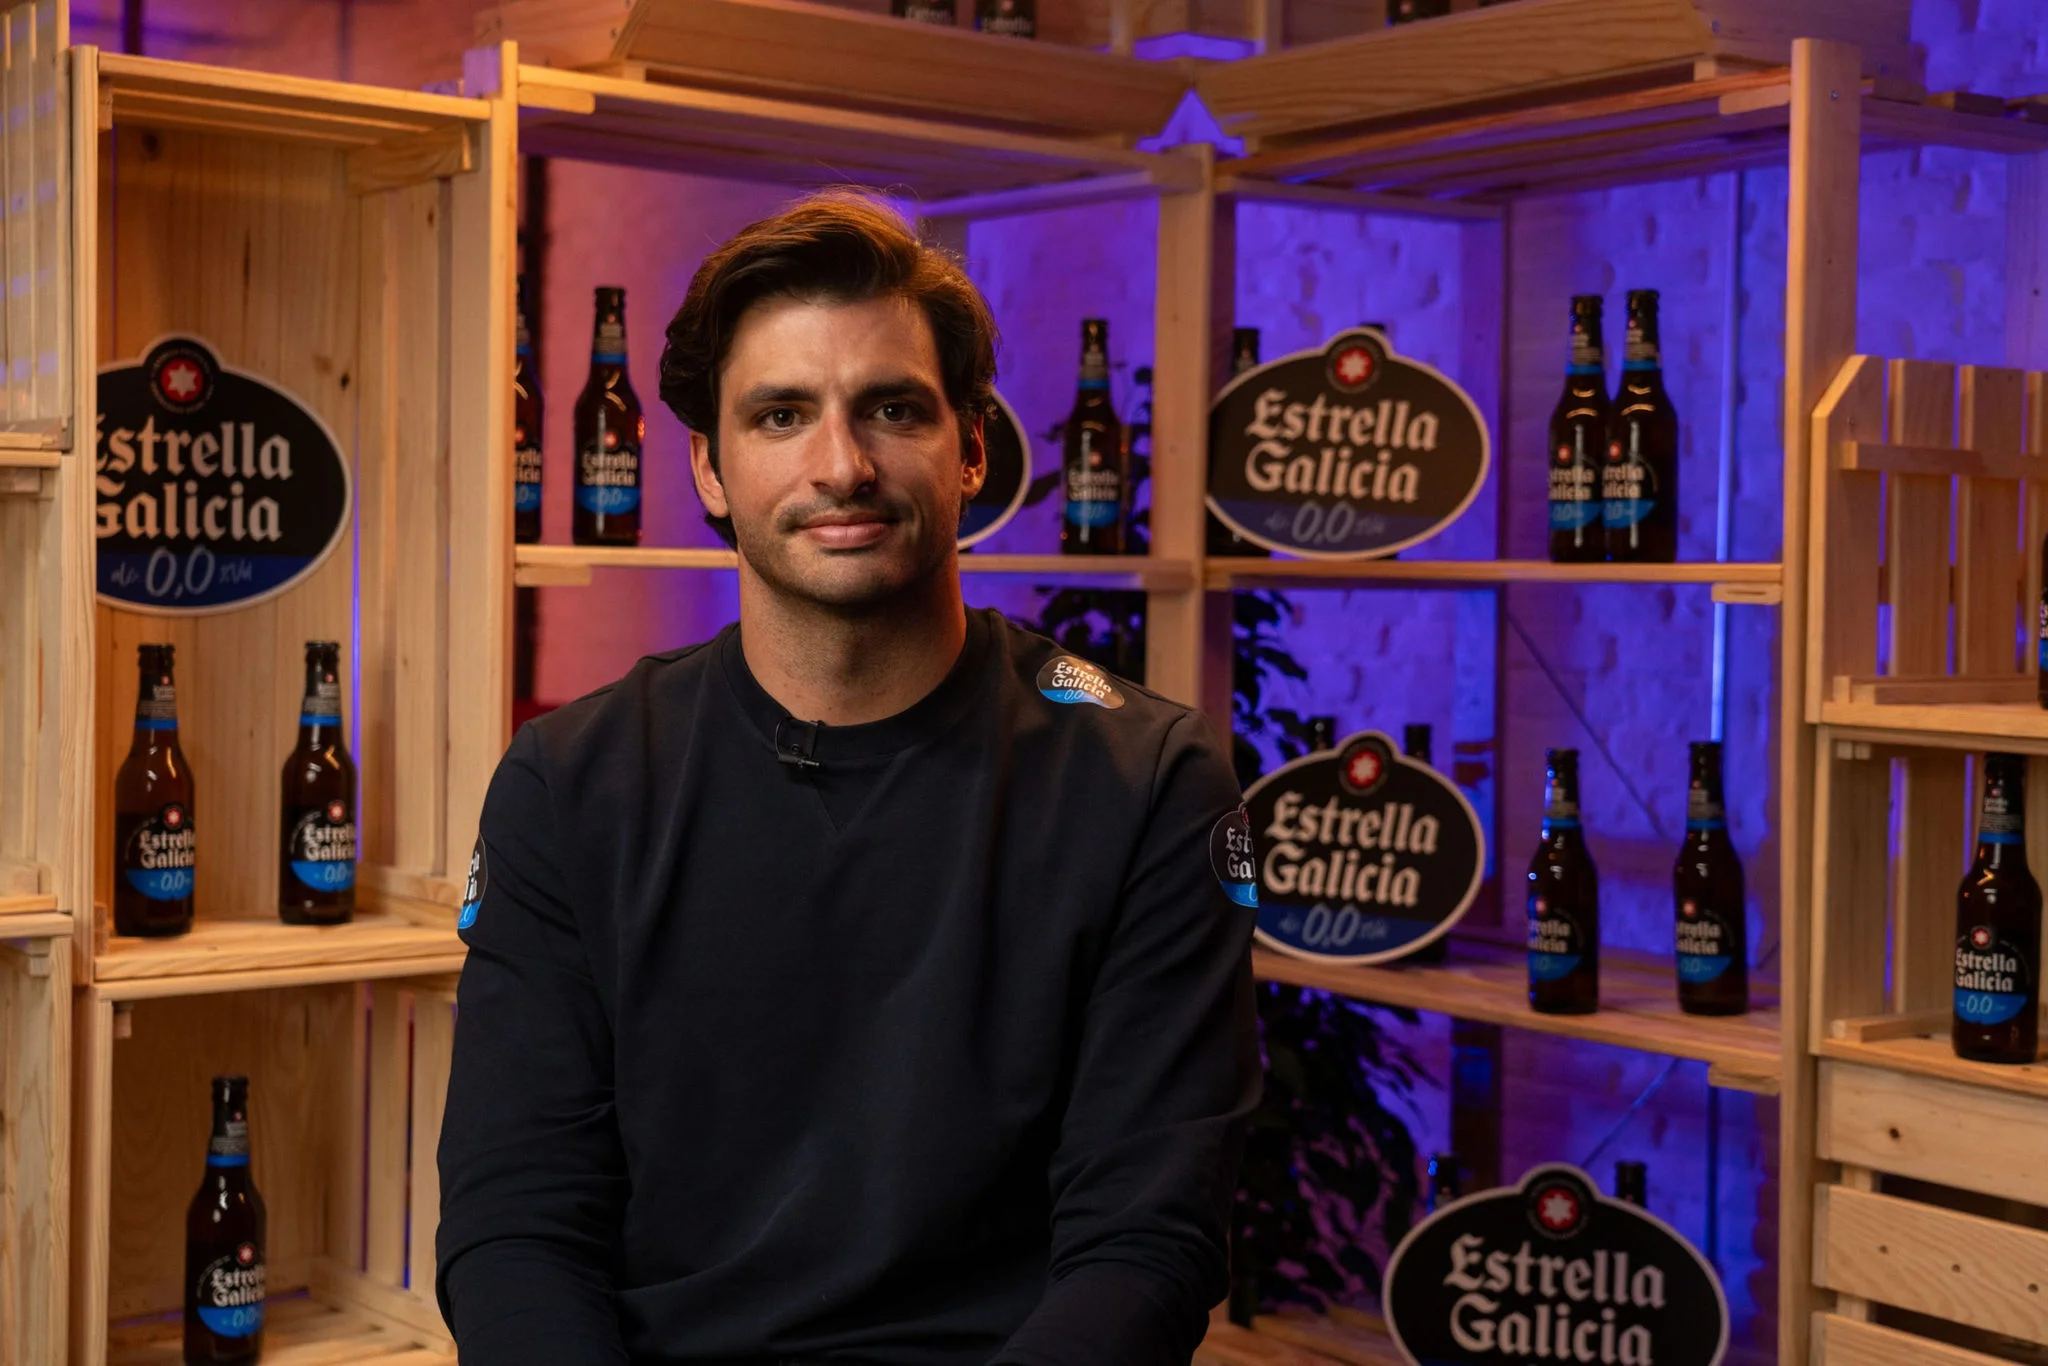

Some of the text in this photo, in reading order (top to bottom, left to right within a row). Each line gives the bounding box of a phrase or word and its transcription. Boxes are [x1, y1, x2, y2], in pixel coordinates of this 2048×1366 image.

[96, 413, 293, 480] strella
[1245, 388, 1439, 451] Estrella
[1245, 440, 1420, 503] Galicia
[1052, 674, 1105, 699] Galicia
[1053, 661, 1112, 693] Estrella
[1264, 790, 1440, 855] Estrella
[1263, 840, 1421, 908] Galicia
[1443, 1233, 1665, 1310] Estrella
[1449, 1292, 1653, 1366] Galicia
